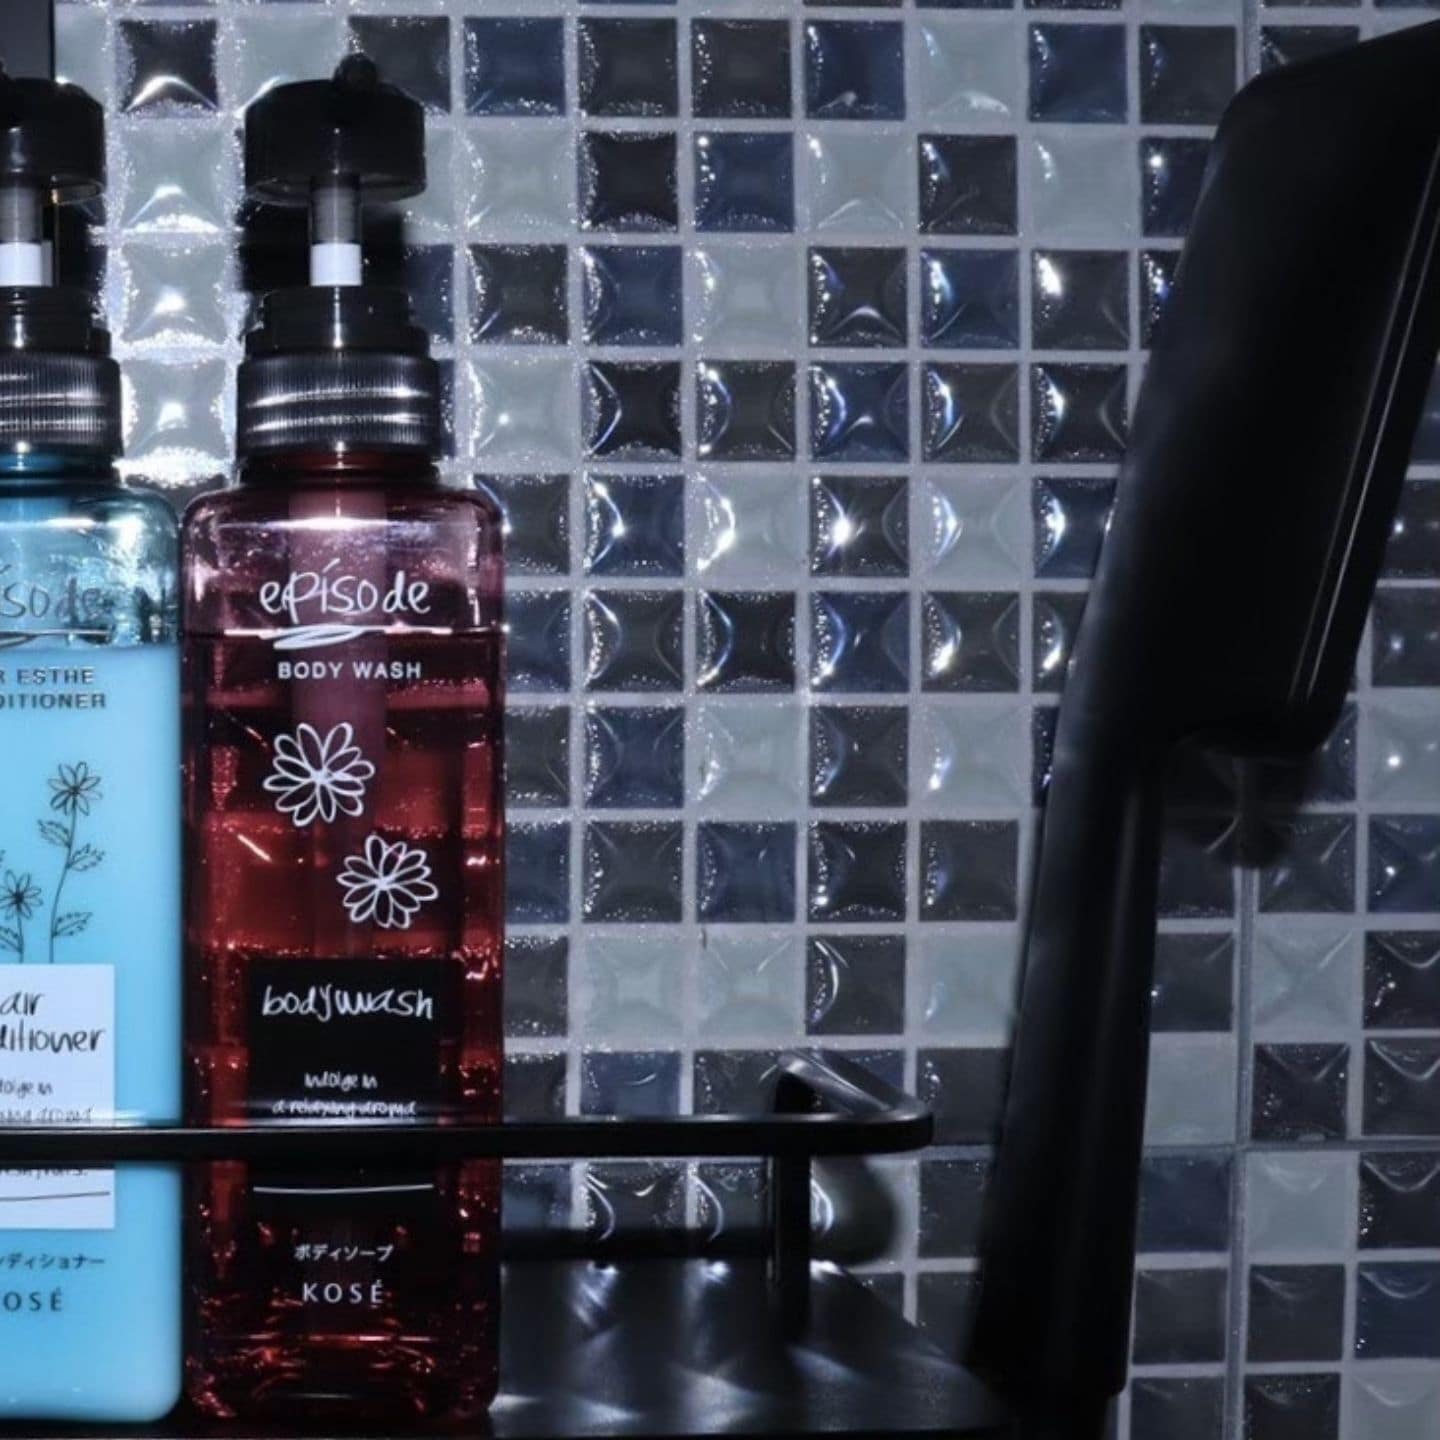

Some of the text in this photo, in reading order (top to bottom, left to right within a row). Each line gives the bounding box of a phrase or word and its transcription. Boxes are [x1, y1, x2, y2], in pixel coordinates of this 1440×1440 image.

[260, 558, 430, 625] episode
[16, 667, 95, 685] ESTHE
[278, 662, 422, 679] BODY WASH
[294, 1244, 394, 1262] ボディソープ
[303, 1280, 383, 1304] KOSÉ
